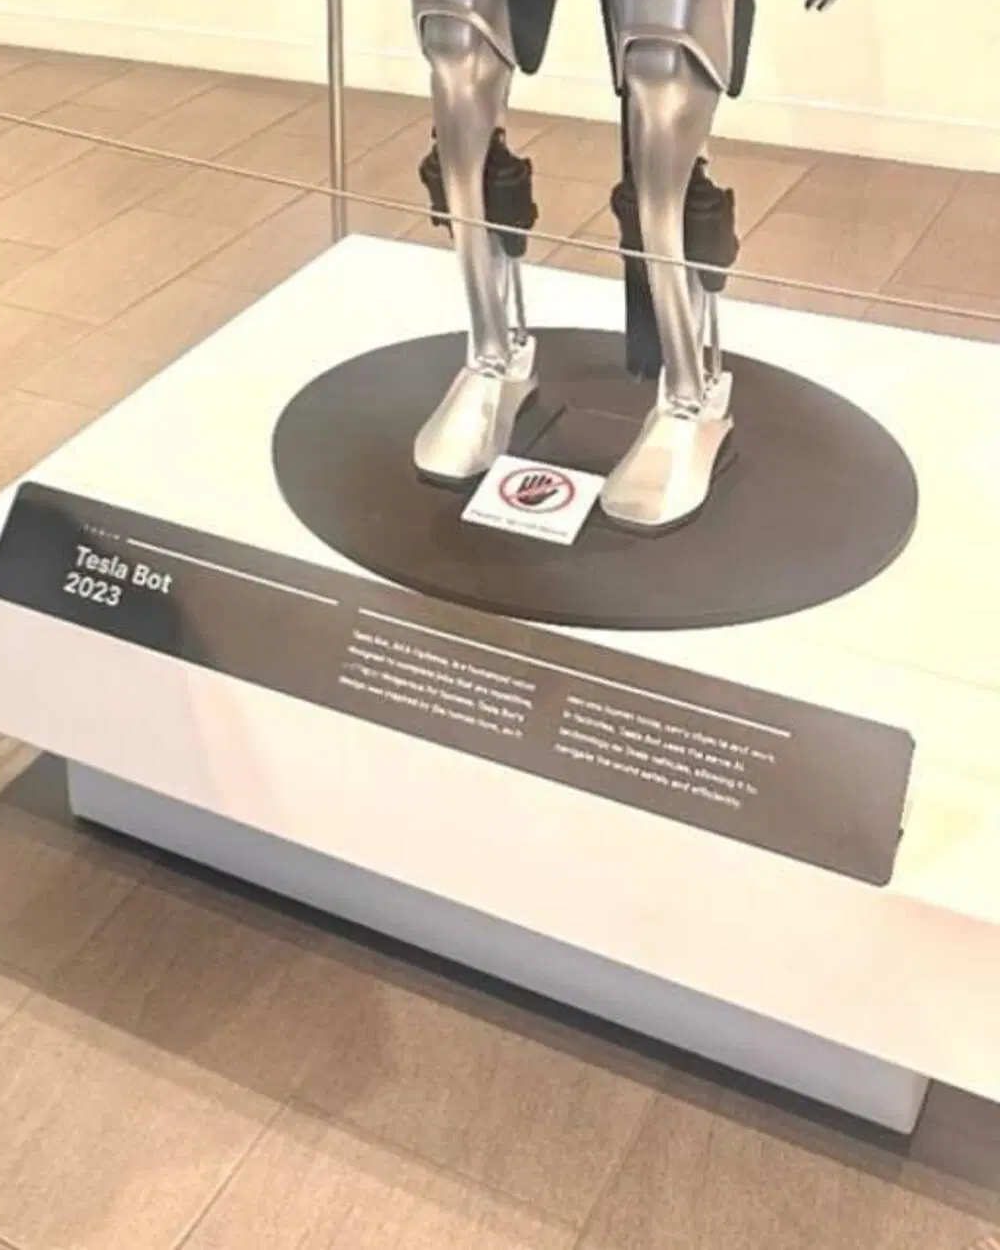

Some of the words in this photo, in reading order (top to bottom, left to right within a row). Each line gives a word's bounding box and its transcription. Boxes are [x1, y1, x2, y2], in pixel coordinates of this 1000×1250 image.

[62, 571, 123, 607] 2023
[75, 544, 129, 580] Tesla
[131, 563, 173, 594] Bot
